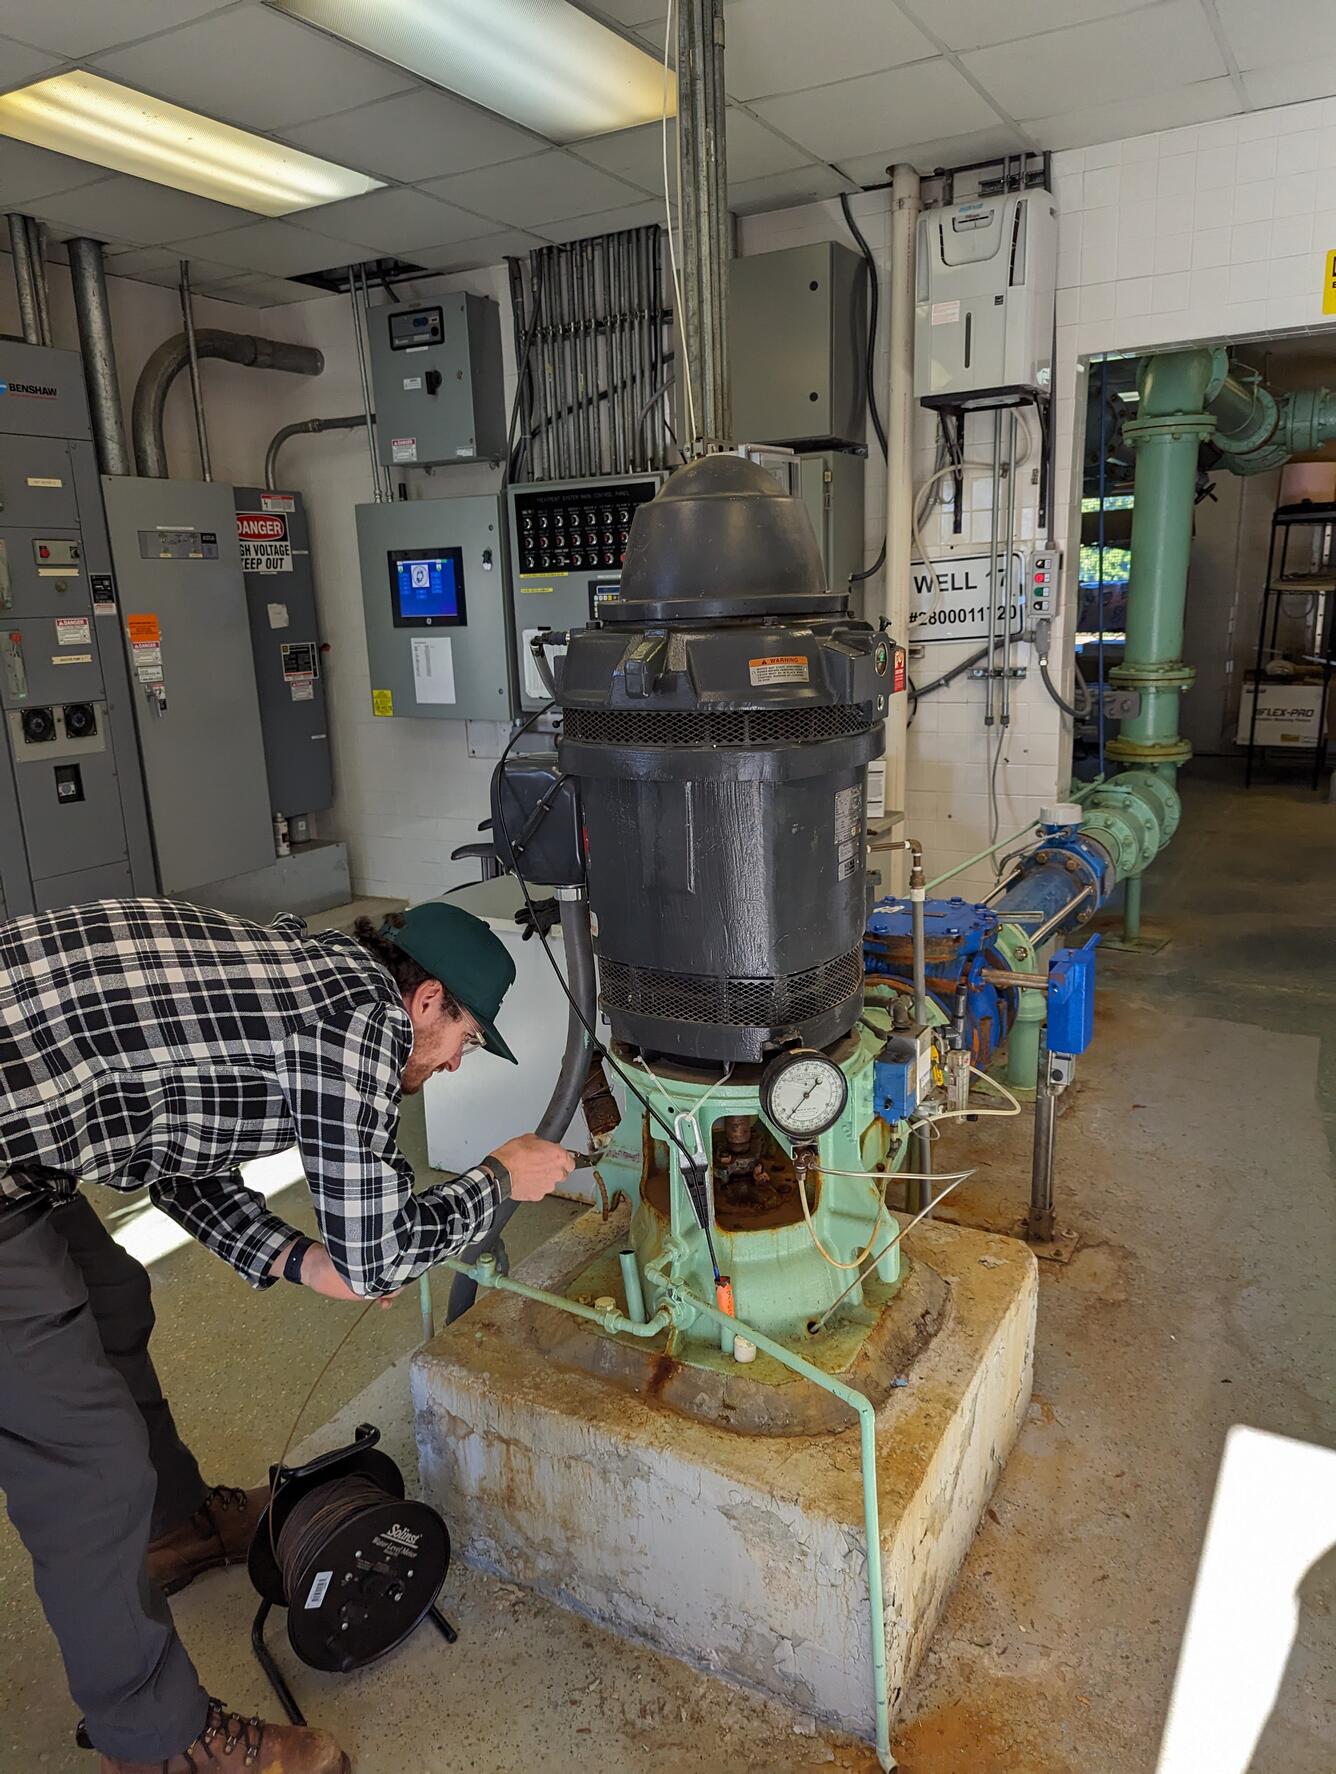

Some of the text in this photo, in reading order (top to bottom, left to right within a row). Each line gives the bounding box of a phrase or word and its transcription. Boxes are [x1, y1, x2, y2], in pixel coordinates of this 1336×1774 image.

[8, 383, 57, 396] BENSHAW
[236, 521, 282, 535] DANGER
[240, 544, 290, 557] GH VOLTAGE
[241, 557, 284, 570] EEP OUT
[913, 571, 978, 594] WELL
[909, 604, 1017, 626] #280001120
[387, 1523, 420, 1545] Solinst
[371, 1536, 388, 1548] Water
[387, 1542, 403, 1554] Level
